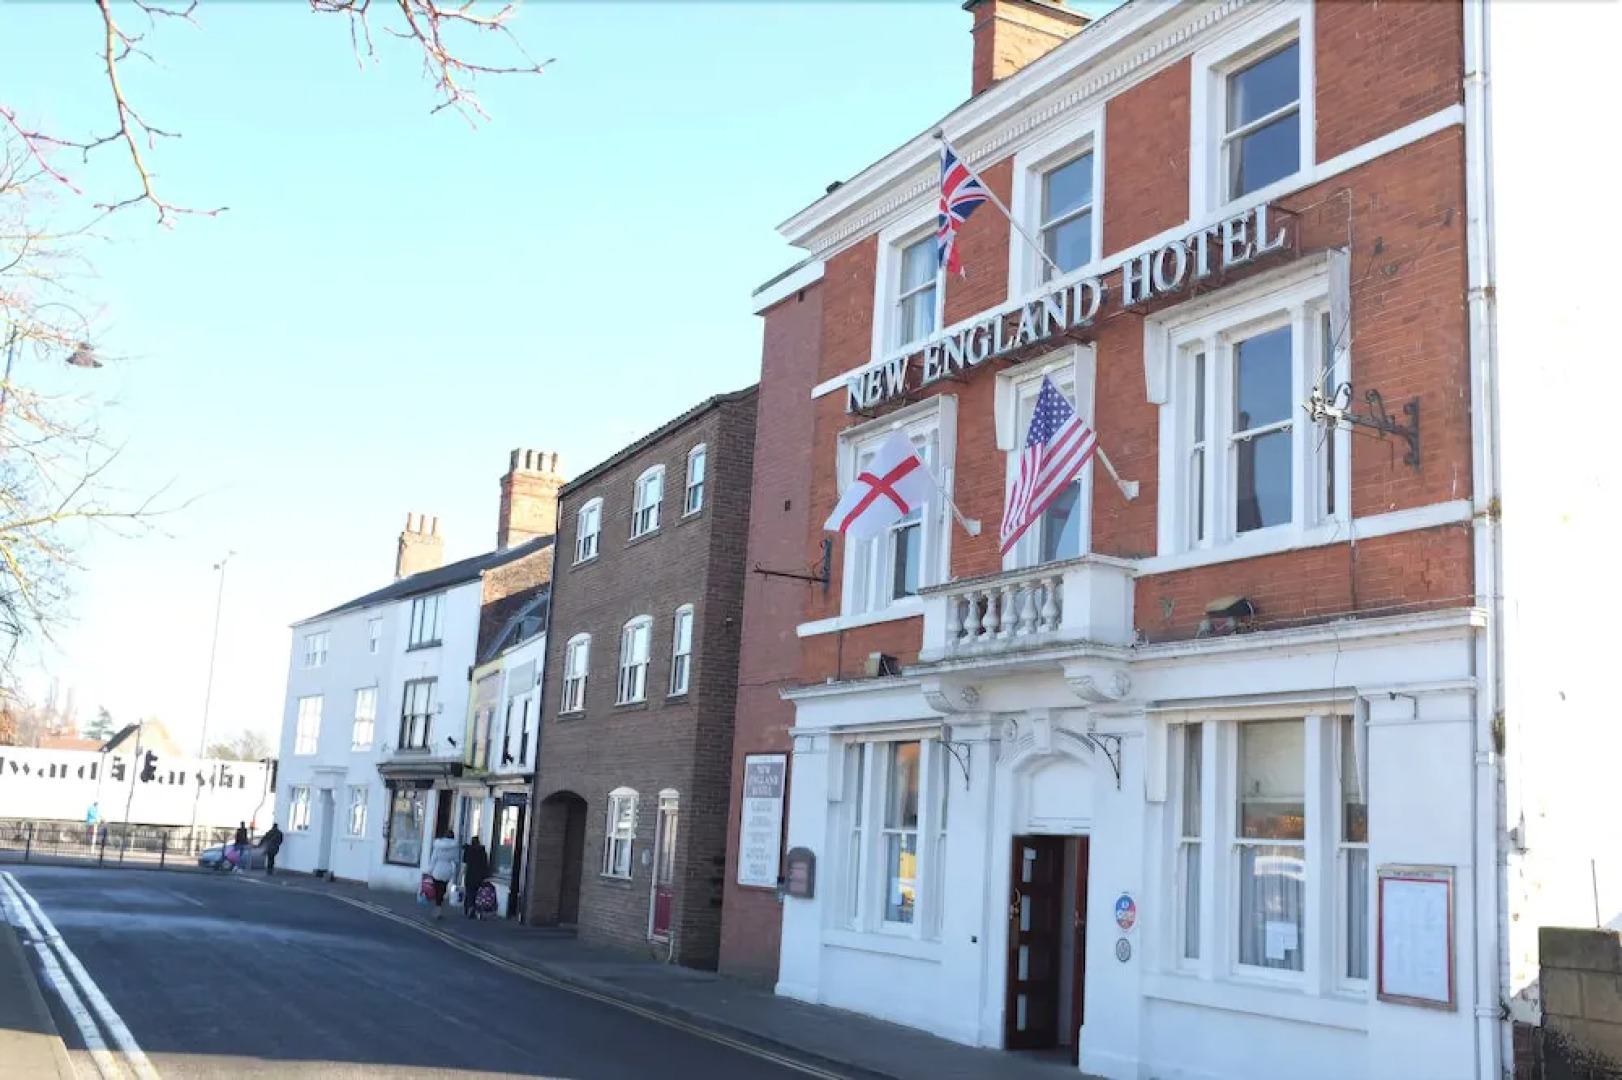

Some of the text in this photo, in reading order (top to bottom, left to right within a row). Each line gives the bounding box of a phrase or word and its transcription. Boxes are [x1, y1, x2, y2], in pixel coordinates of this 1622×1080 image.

[845, 203, 1286, 414] NEW ENGLAND HOTEL
